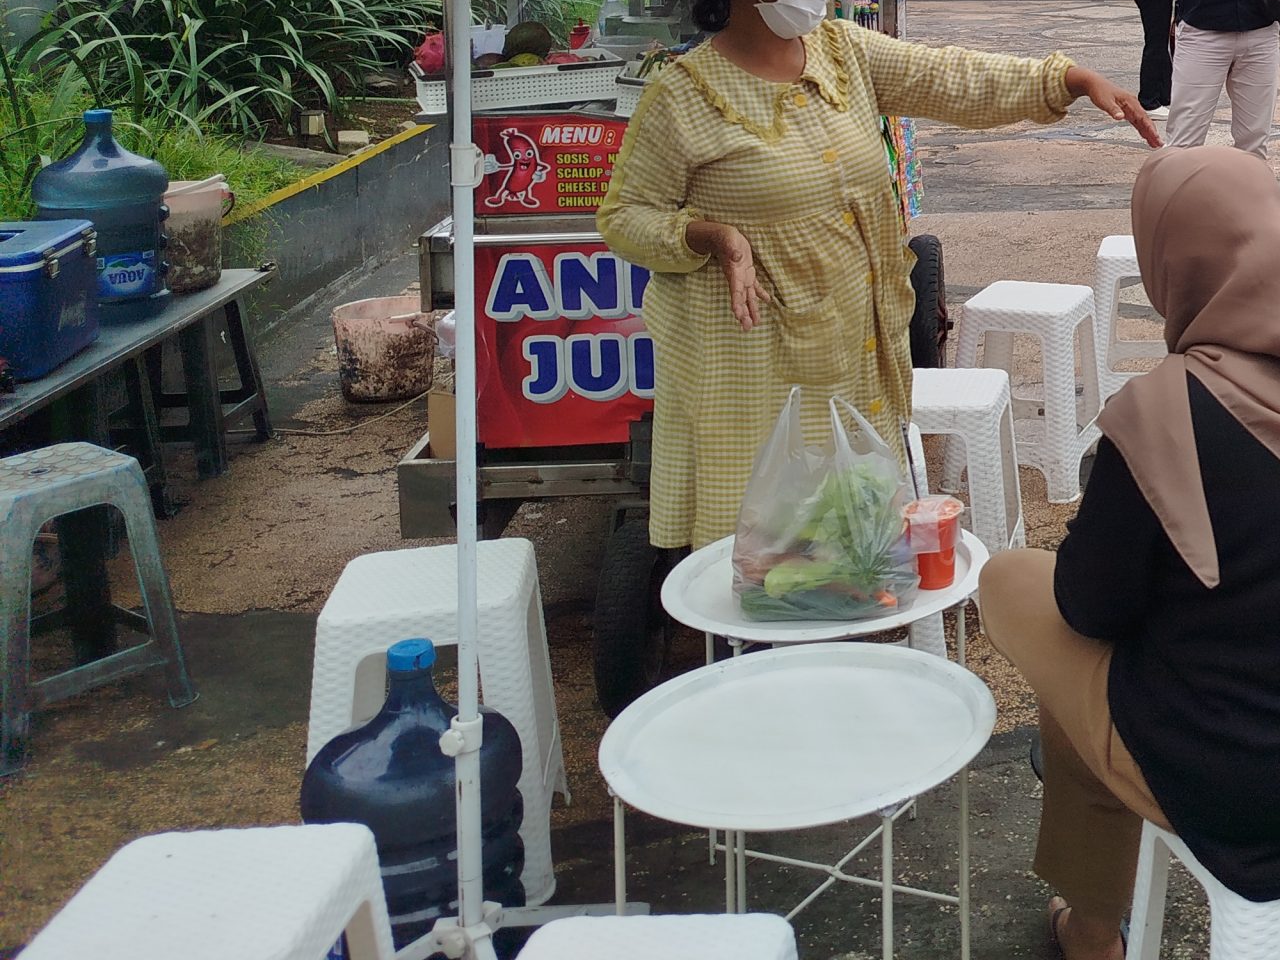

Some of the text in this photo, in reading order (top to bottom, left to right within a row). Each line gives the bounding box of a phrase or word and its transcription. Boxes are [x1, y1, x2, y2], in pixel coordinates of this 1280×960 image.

[541, 125, 603, 145] MENU
[556, 153, 590, 164] SOSIS
[557, 168, 603, 179] SCALLOP
[557, 182, 597, 193] CHEESE
[523, 333, 656, 403] JUI
